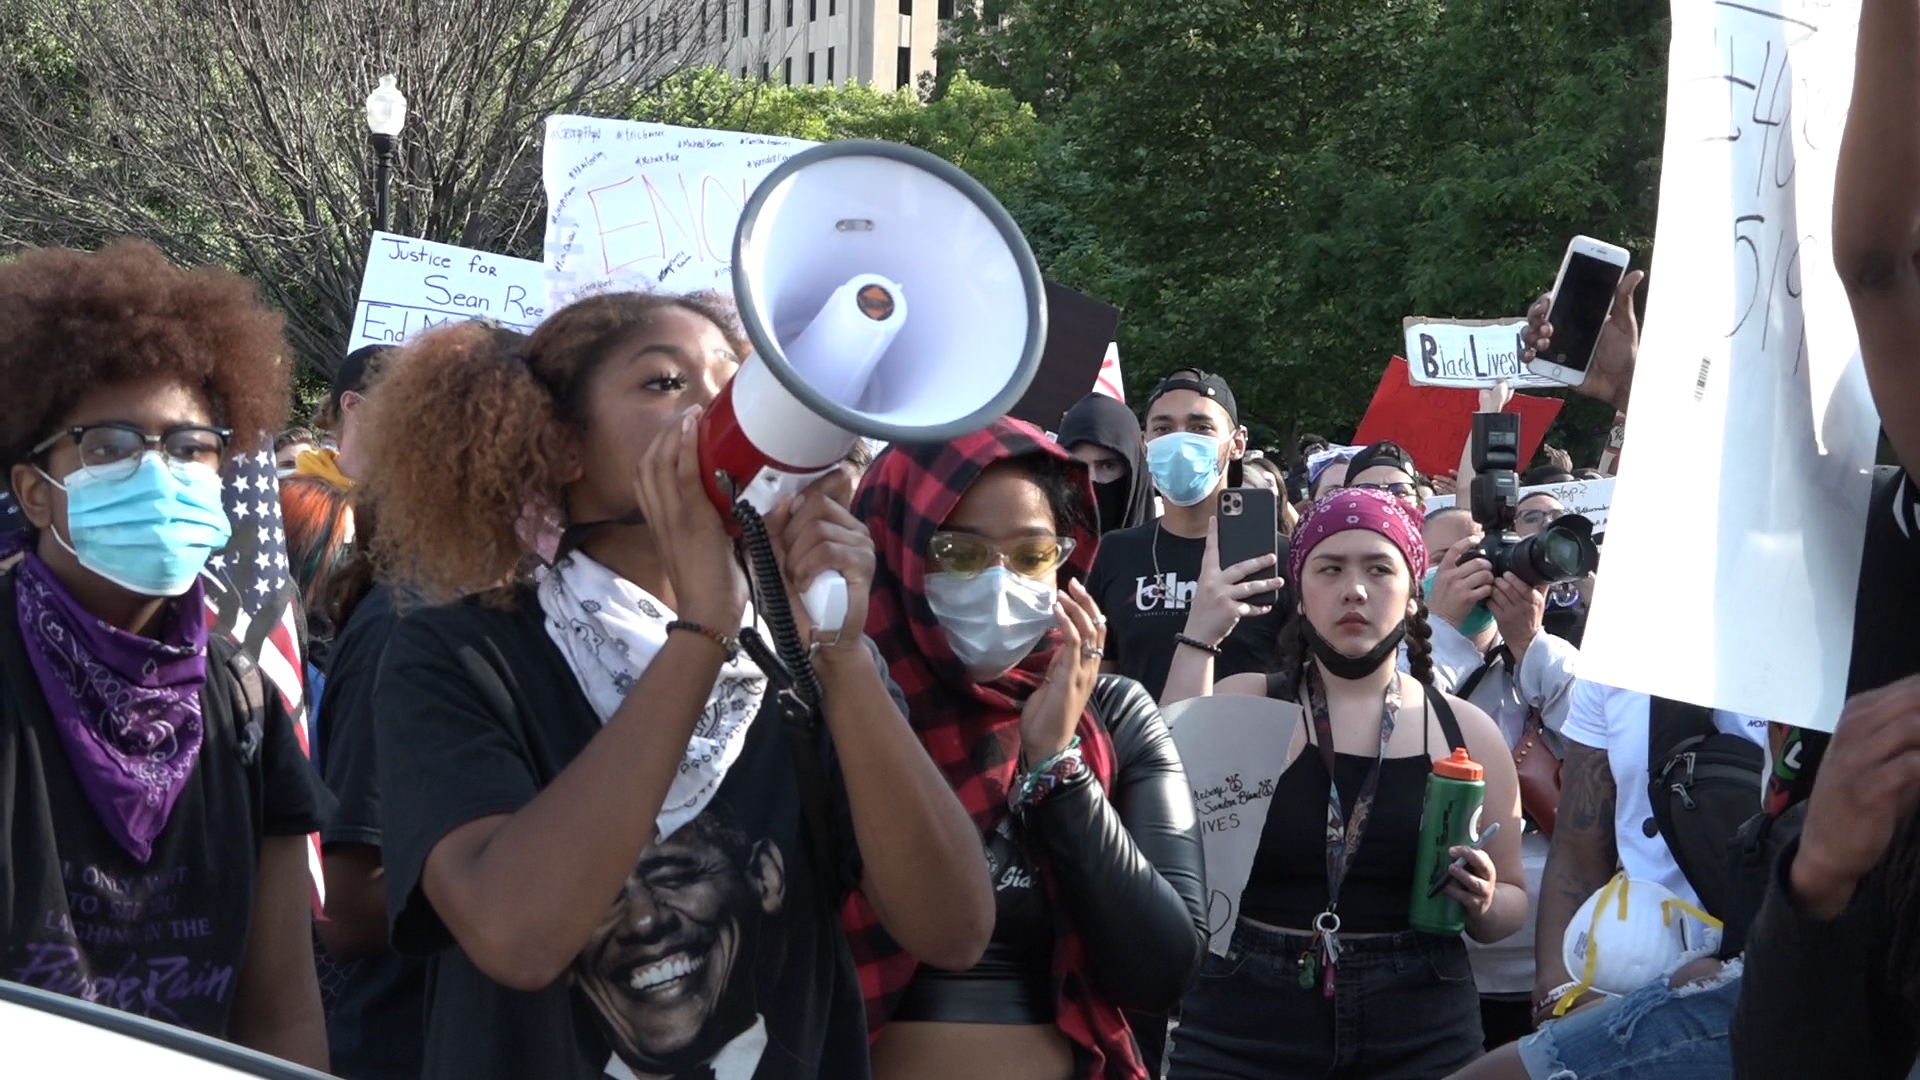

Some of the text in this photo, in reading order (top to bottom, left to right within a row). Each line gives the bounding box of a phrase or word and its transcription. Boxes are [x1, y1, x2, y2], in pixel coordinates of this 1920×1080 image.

[381, 238, 451, 269] Justice
[424, 274, 490, 311] Sean
[504, 285, 544, 318] Ree
[362, 303, 408, 342] End
[1419, 333, 1472, 378] Black
[1552, 483, 1588, 502] Stop?
[1202, 812, 1241, 836] IVES
[82, 865, 133, 895] ONLY
[996, 866, 1031, 891] Gia
[69, 892, 99, 914] TO
[170, 917, 212, 939] THE
[141, 956, 233, 1030] Rain
